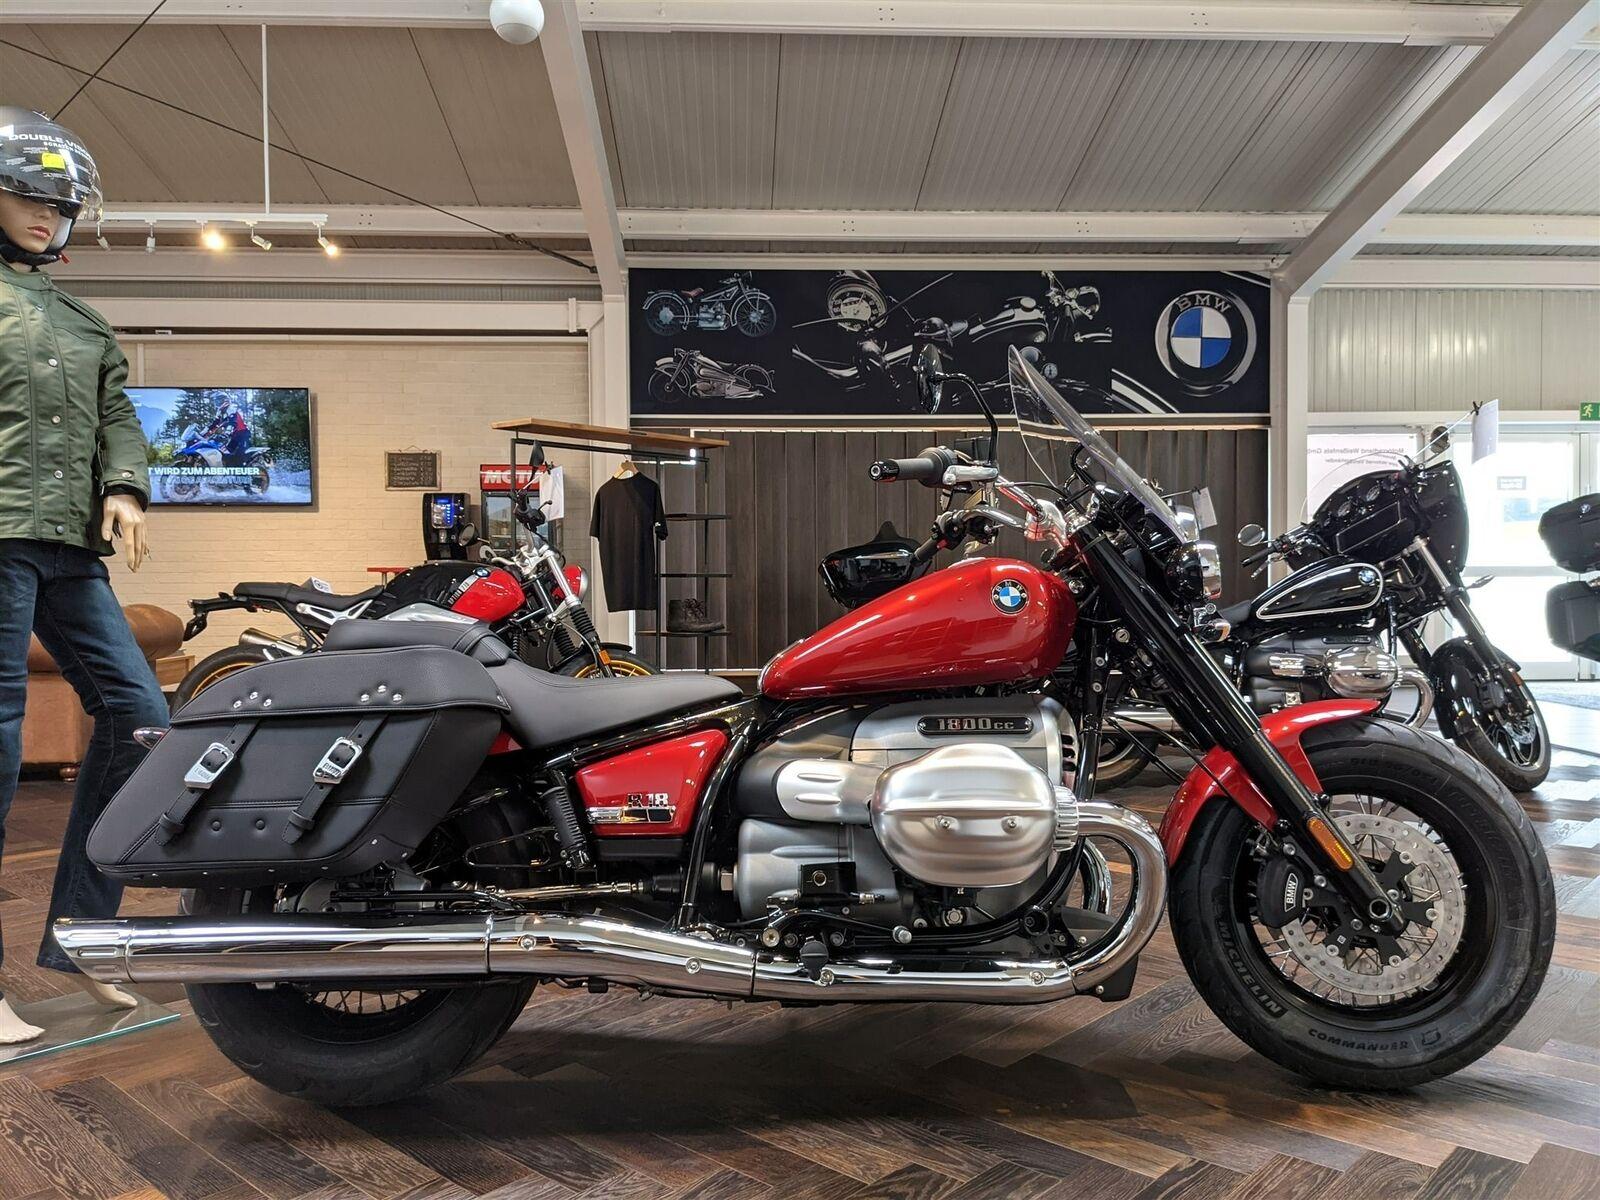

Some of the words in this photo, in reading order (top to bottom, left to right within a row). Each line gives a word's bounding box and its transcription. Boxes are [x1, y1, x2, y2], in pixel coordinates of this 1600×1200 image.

[9, 133, 65, 144] DOUBLE
[1176, 294, 1231, 312] BMW
[154, 467, 180, 475] WIRD
[181, 467, 203, 475] ZUM
[204, 467, 259, 475] ABENTEUER
[484, 469, 540, 484] MOTU
[996, 582, 1023, 592] BMW
[938, 718, 1014, 731] 1800cc
[1286, 880, 1296, 903] BMW
[1219, 921, 1282, 1013] MICHELIN
[1308, 1028, 1409, 1052] COMMANDER
